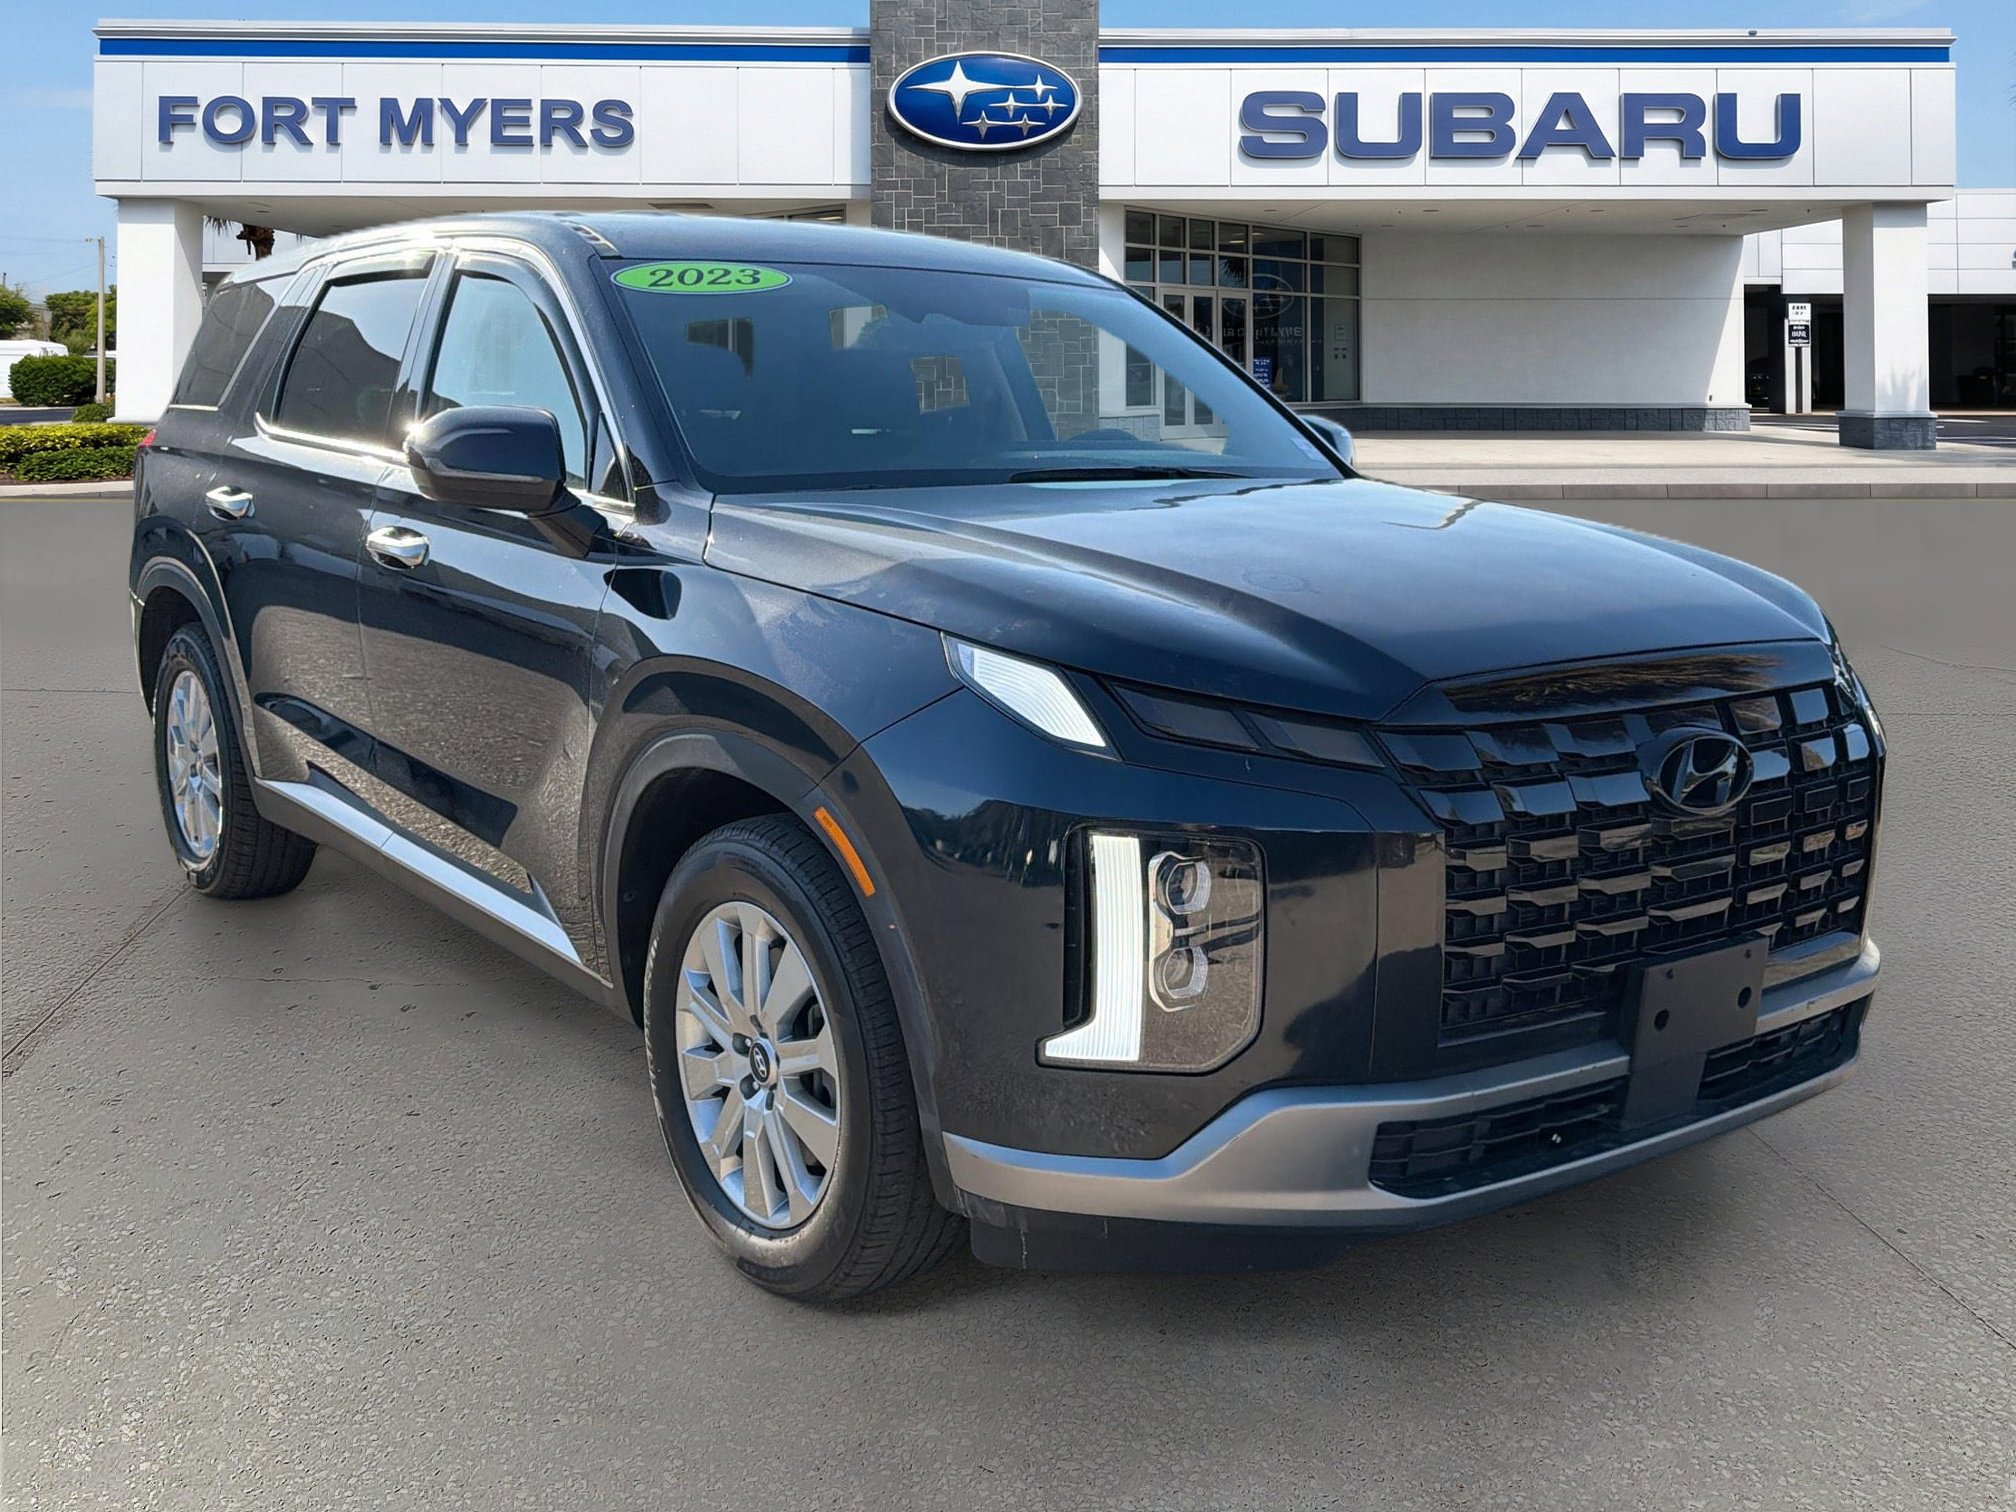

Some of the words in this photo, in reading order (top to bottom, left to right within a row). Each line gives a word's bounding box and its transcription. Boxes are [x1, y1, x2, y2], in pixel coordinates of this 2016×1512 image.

[158, 95, 358, 146] FORT
[379, 97, 635, 147] MYERS
[1239, 90, 1802, 161] SUBARU
[648, 267, 762, 288] 2023
